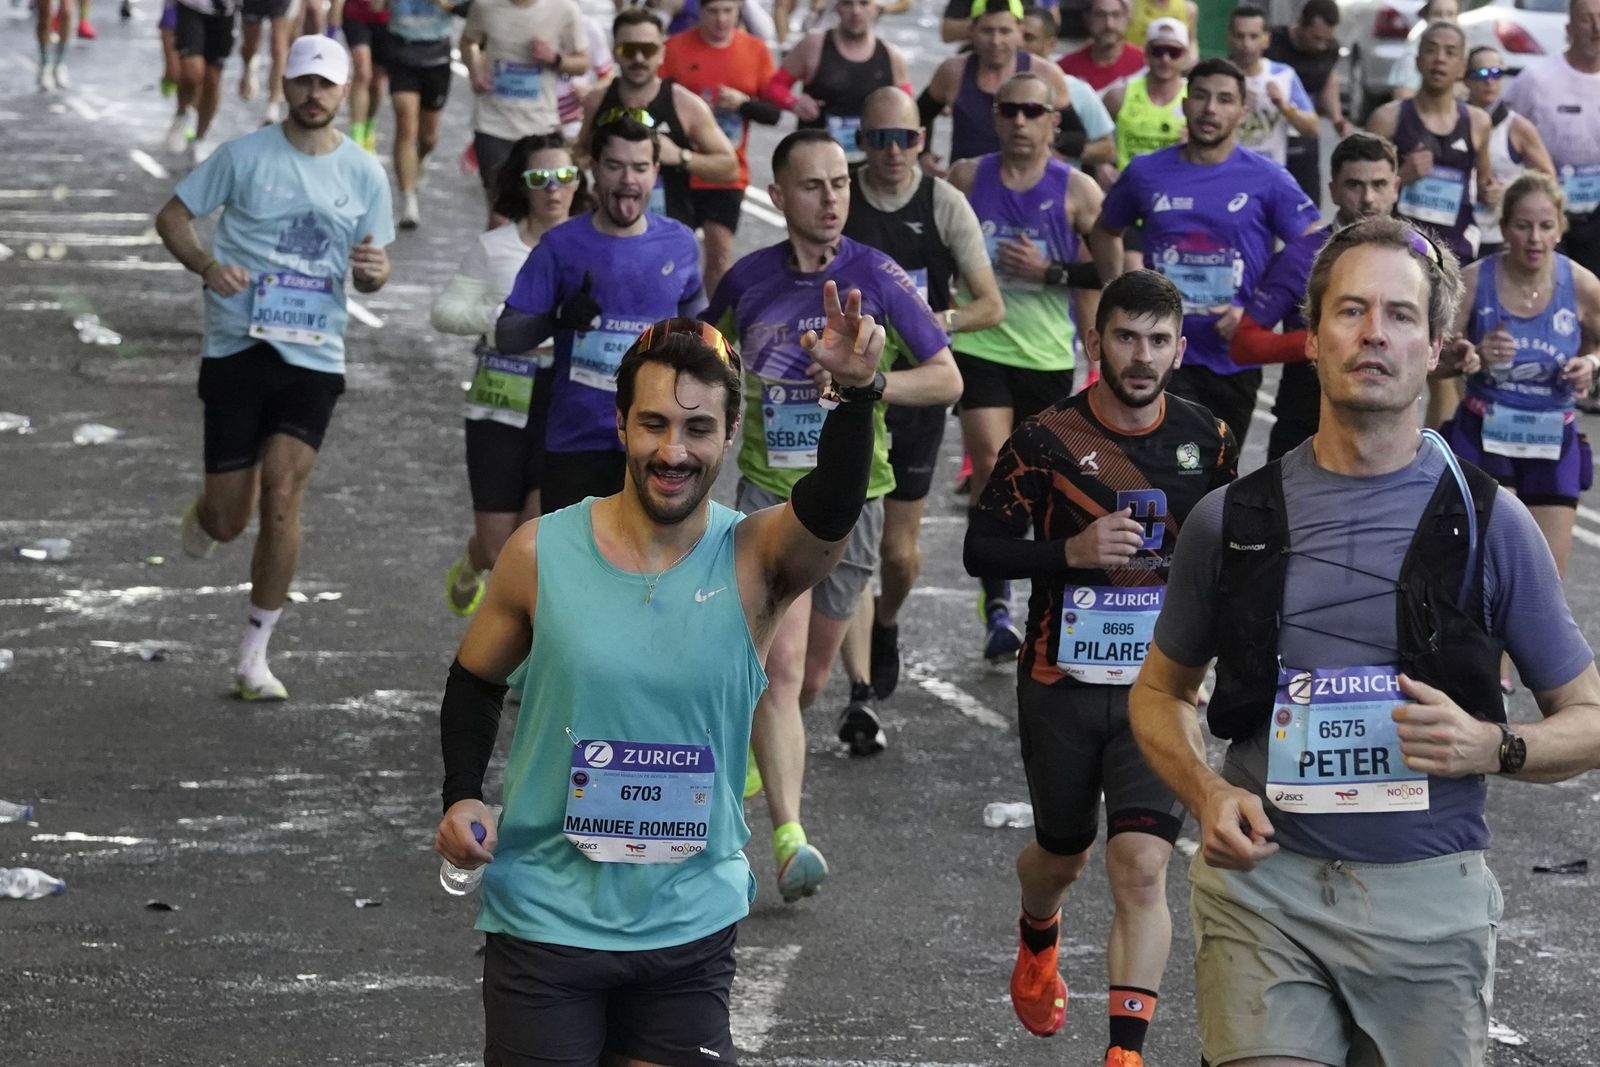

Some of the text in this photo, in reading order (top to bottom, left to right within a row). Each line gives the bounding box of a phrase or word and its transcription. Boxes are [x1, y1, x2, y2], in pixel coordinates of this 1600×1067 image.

[253, 307, 328, 329] JOAQUIN G
[767, 428, 822, 448] SÉBAS
[1229, 541, 1266, 551] SALOMON
[1103, 592, 1160, 607] ZURICH
[1102, 622, 1135, 636] 8695
[1315, 674, 1401, 696] ZURICH
[1319, 719, 1366, 739] 6575
[622, 749, 700, 766] ZURICH
[1299, 747, 1390, 778] PETER
[620, 785, 662, 802] 6703
[565, 815, 708, 838] MANUEE ROMERO
